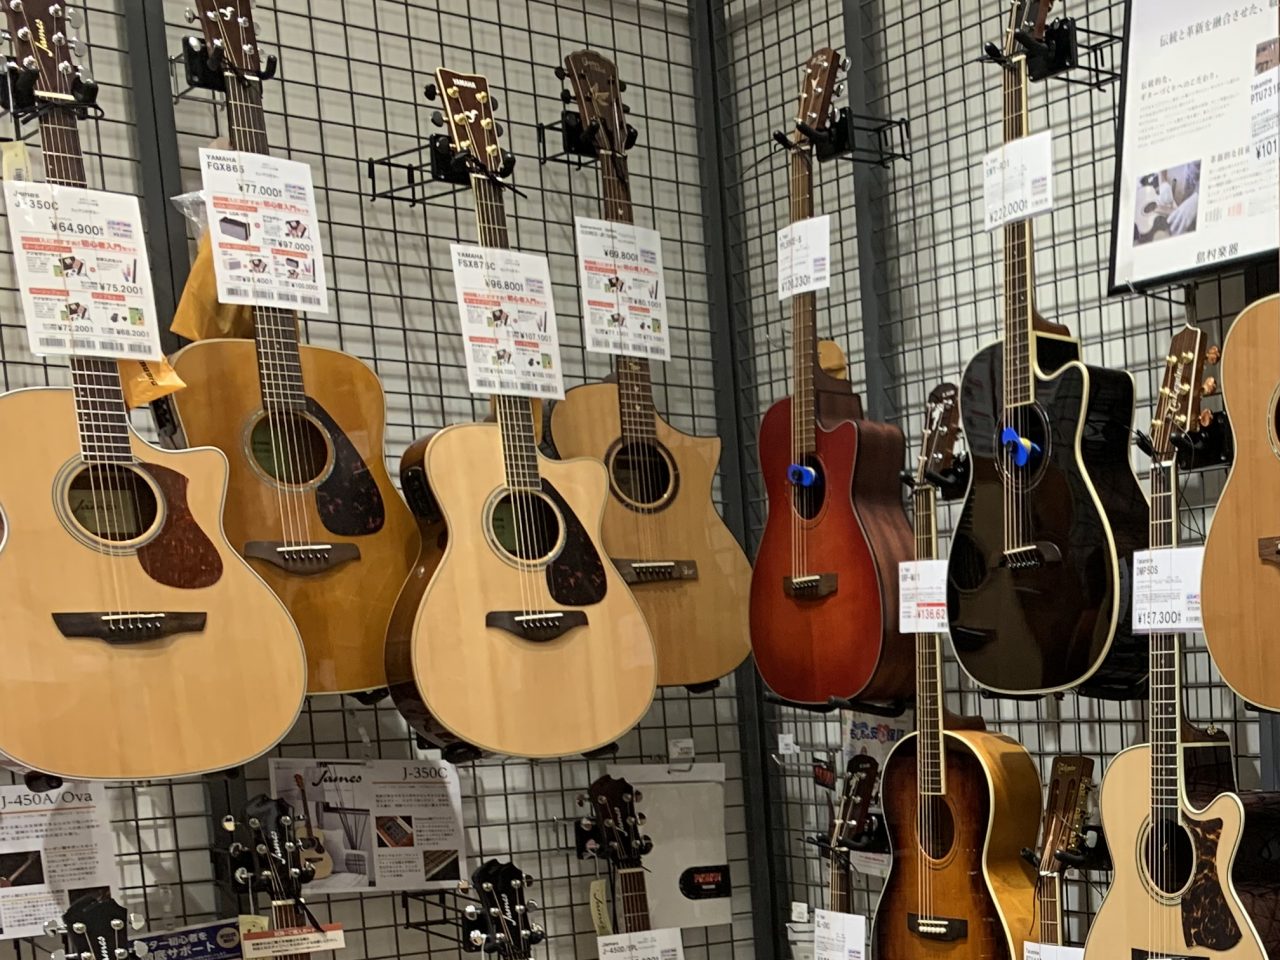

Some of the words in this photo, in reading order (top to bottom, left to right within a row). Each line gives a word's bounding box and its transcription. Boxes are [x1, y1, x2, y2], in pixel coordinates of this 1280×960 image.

[452, 78, 477, 89] YAMAHA
[206, 154, 236, 163] YAMAHA
[458, 252, 483, 260] YAMAHA
[1196, 243, 1238, 264] 島村楽器
[312, 770, 362, 787] James
[403, 766, 448, 781] J-350C
[1, 791, 93, 809] J-450A/Ova
